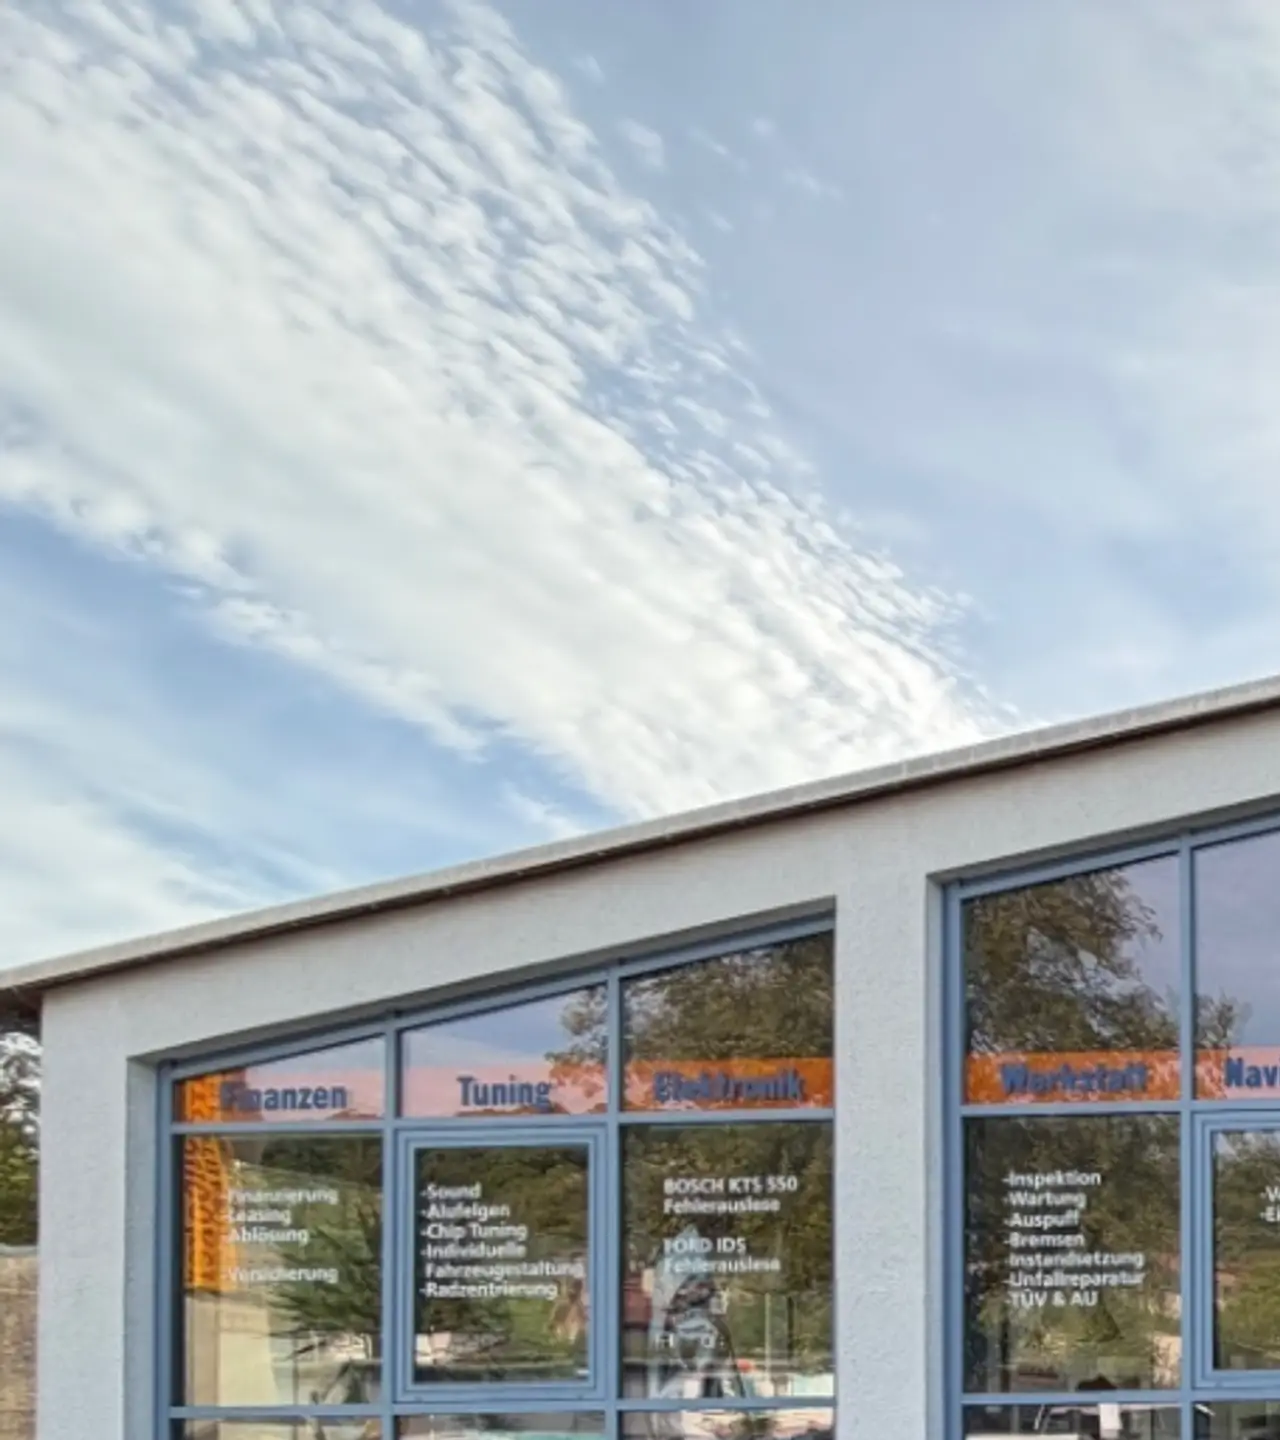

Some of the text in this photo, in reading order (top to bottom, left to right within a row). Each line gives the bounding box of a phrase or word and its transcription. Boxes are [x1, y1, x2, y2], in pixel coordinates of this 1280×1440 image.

[220, 1080, 348, 1111] Finanzen
[456, 1074, 553, 1114] Tuning
[663, 1175, 798, 1194] BOSCH KTS 550
[469, 1222, 529, 1242] Tuning
[663, 1236, 748, 1254] FORD IDS
[1052, 1291, 1067, 1307] &
[1070, 1289, 1099, 1307] AU
